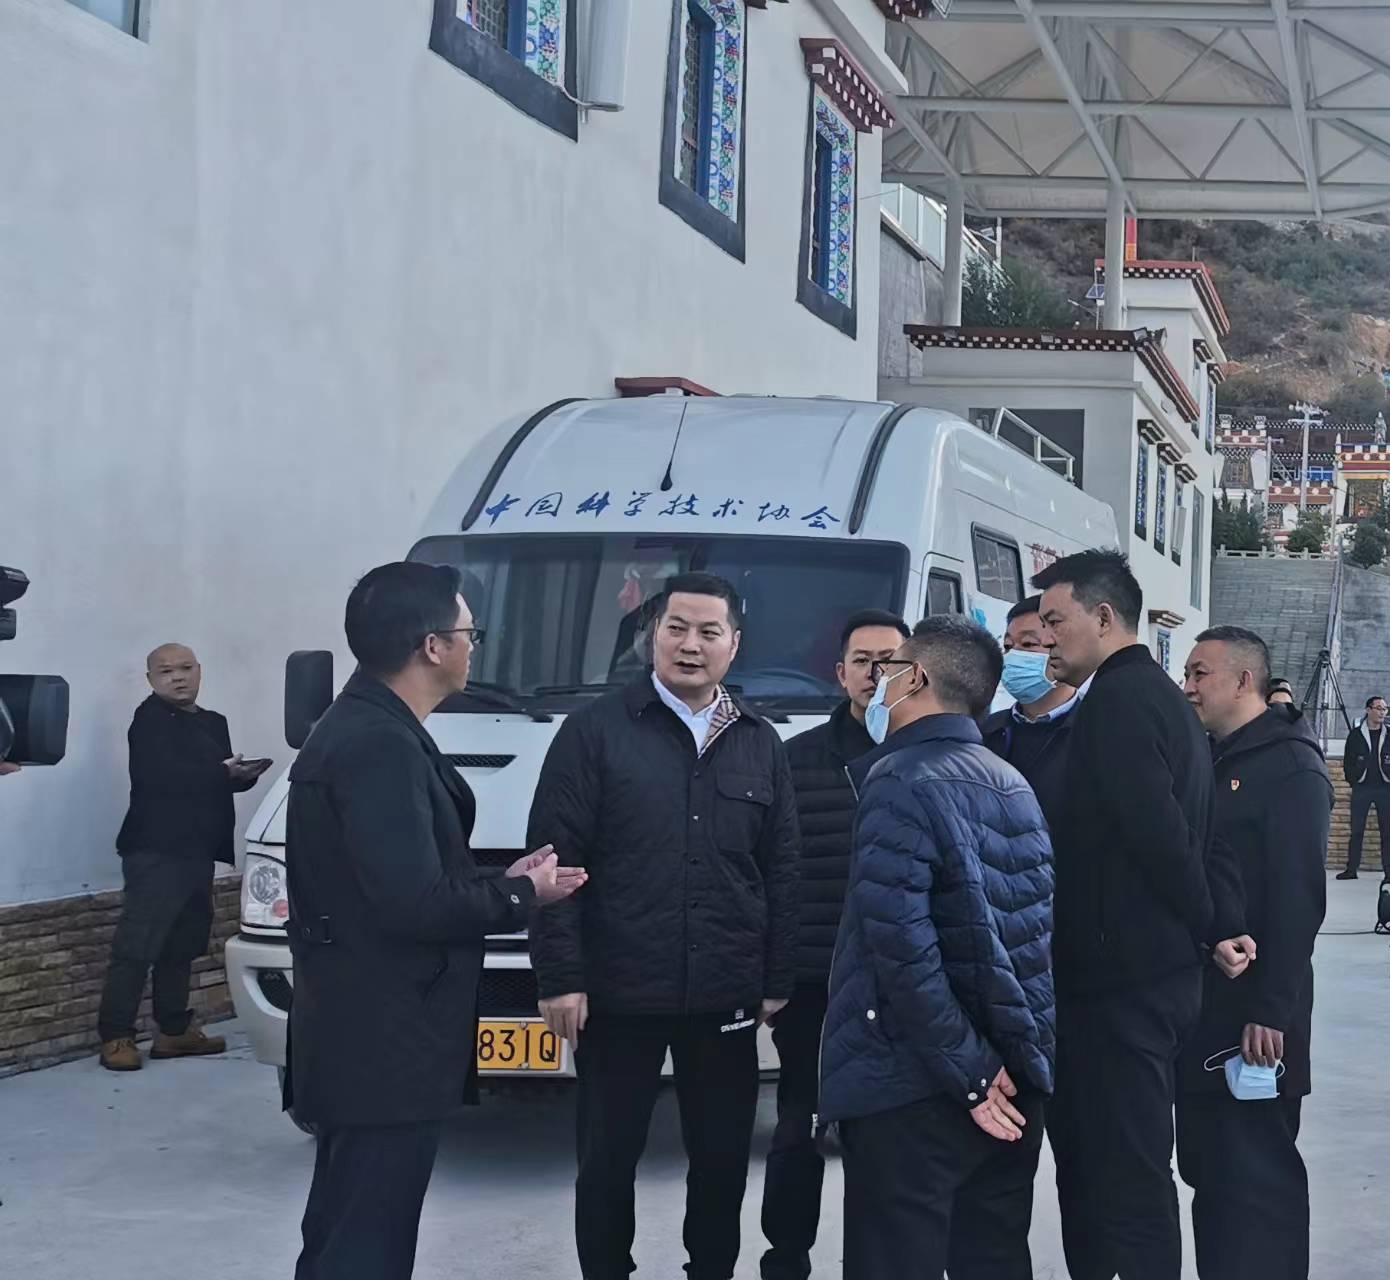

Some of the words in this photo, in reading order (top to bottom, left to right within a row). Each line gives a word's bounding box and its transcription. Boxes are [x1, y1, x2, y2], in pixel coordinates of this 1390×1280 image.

[485, 490, 841, 529] 中国科学技术协会
